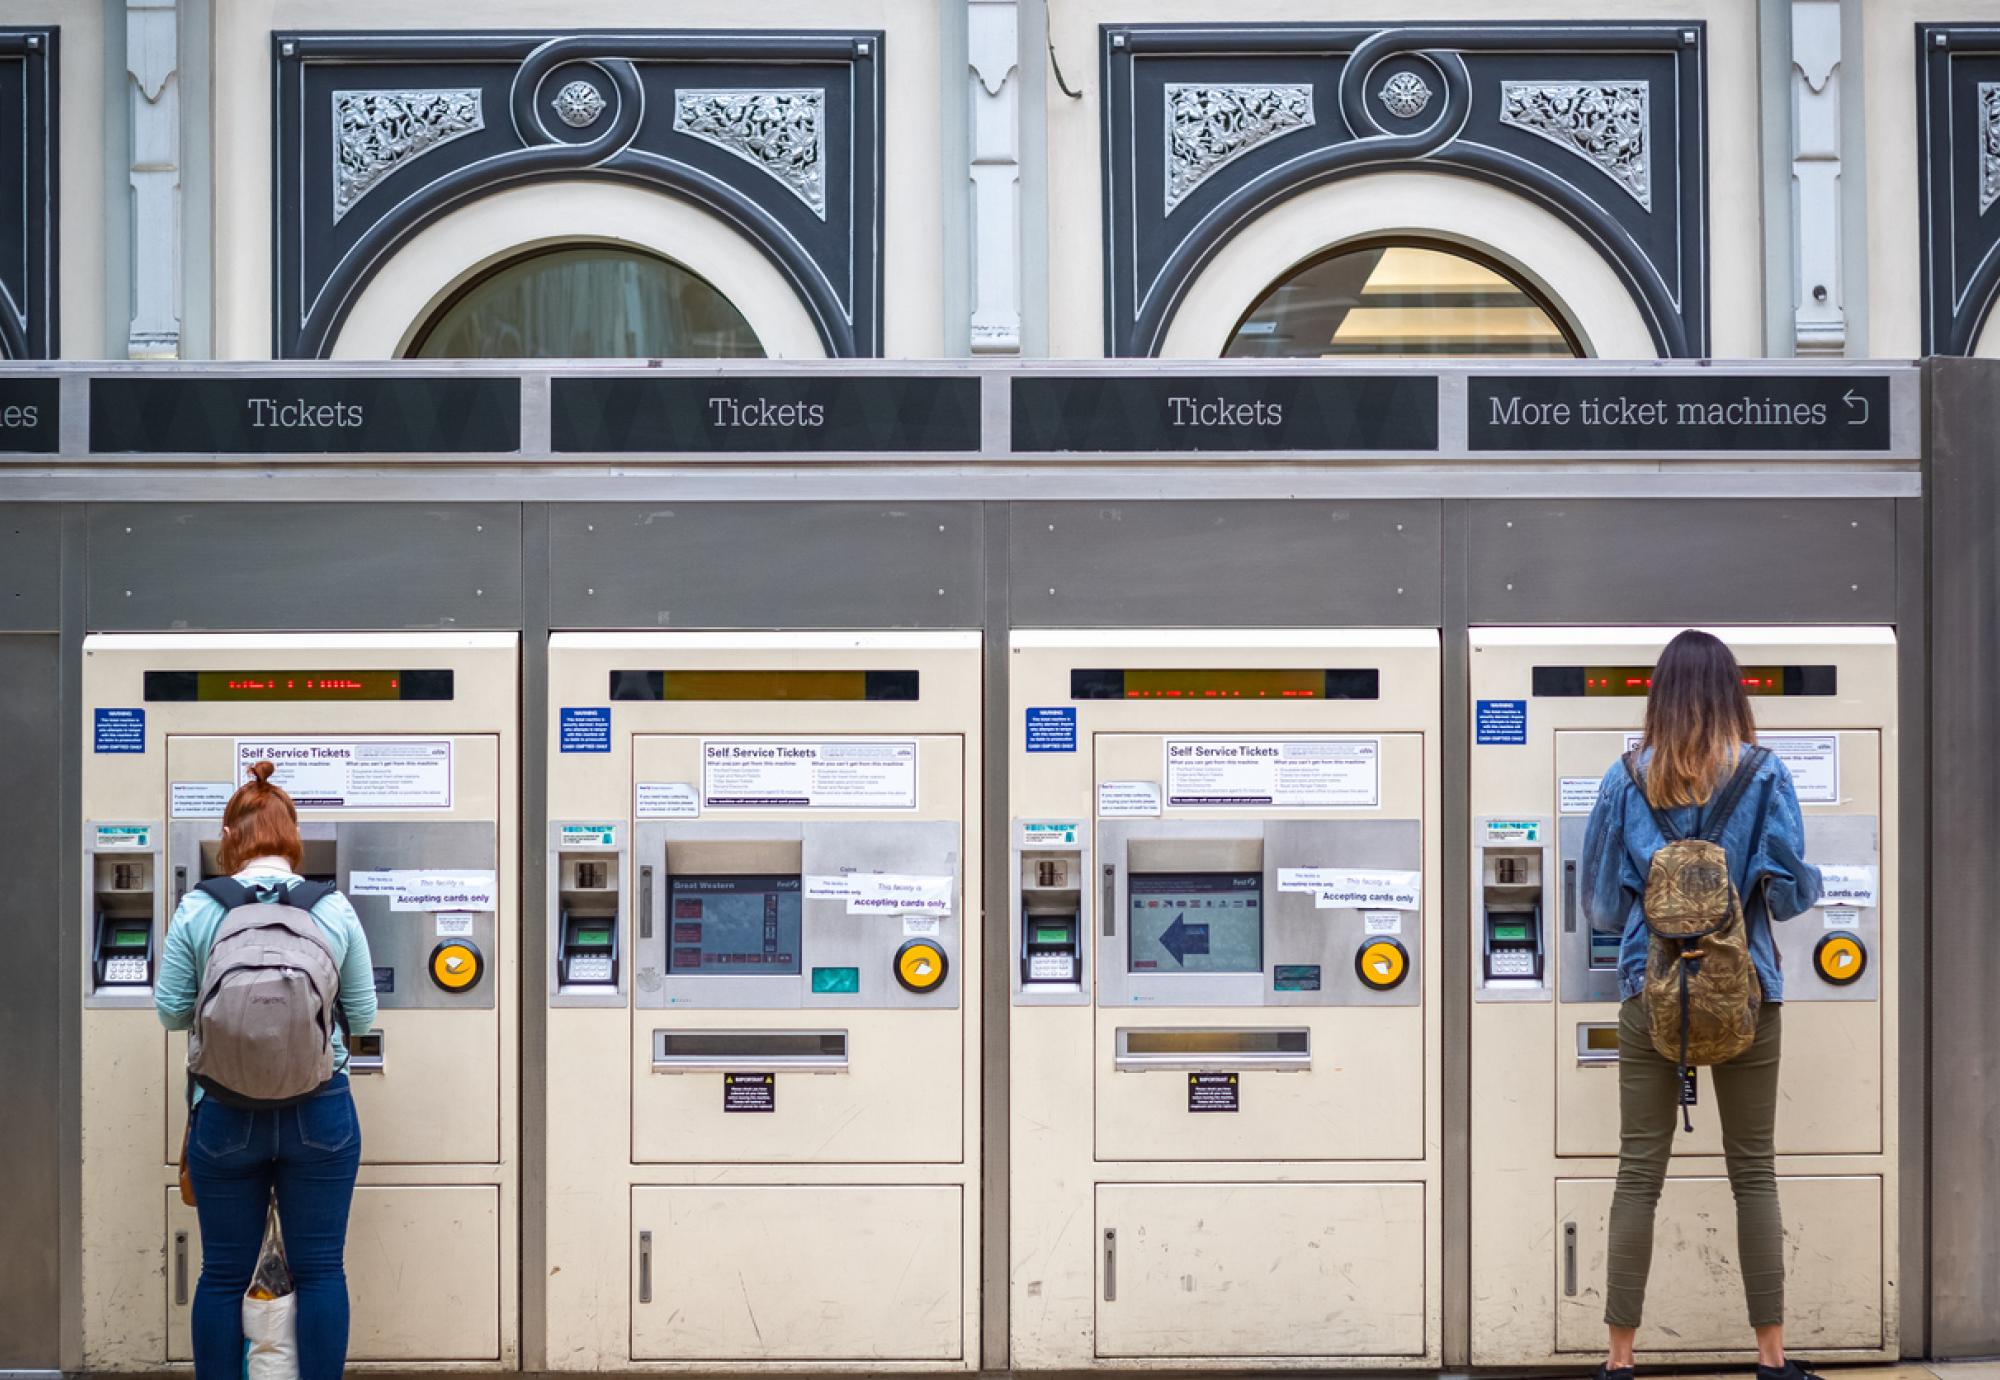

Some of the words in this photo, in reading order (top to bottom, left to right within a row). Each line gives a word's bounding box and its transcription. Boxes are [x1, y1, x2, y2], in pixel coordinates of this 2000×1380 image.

[248, 398, 362, 427] Tickets
[709, 398, 824, 426] Tickets
[1168, 398, 1282, 426] Tickets
[1489, 396, 1570, 425] More
[1580, 396, 1668, 425] ticket
[1677, 397, 1826, 425] machines
[242, 748, 264, 758] Self
[267, 748, 308, 758] Service
[310, 748, 350, 758] Tickets
[708, 747, 729, 758] Self
[732, 747, 774, 758] Service
[776, 747, 816, 758] Tickets
[1170, 746, 1192, 756] Self
[1196, 746, 1238, 756] Service
[1239, 746, 1279, 756] Tickets
[397, 895, 441, 904] Accepting
[470, 894, 489, 903] only
[1323, 892, 1367, 902] Accepting
[1369, 893, 1393, 901] cards
[1396, 894, 1414, 903] only
[1853, 890, 1871, 899] only
[854, 898, 898, 908] Accepting
[927, 900, 946, 909] only
